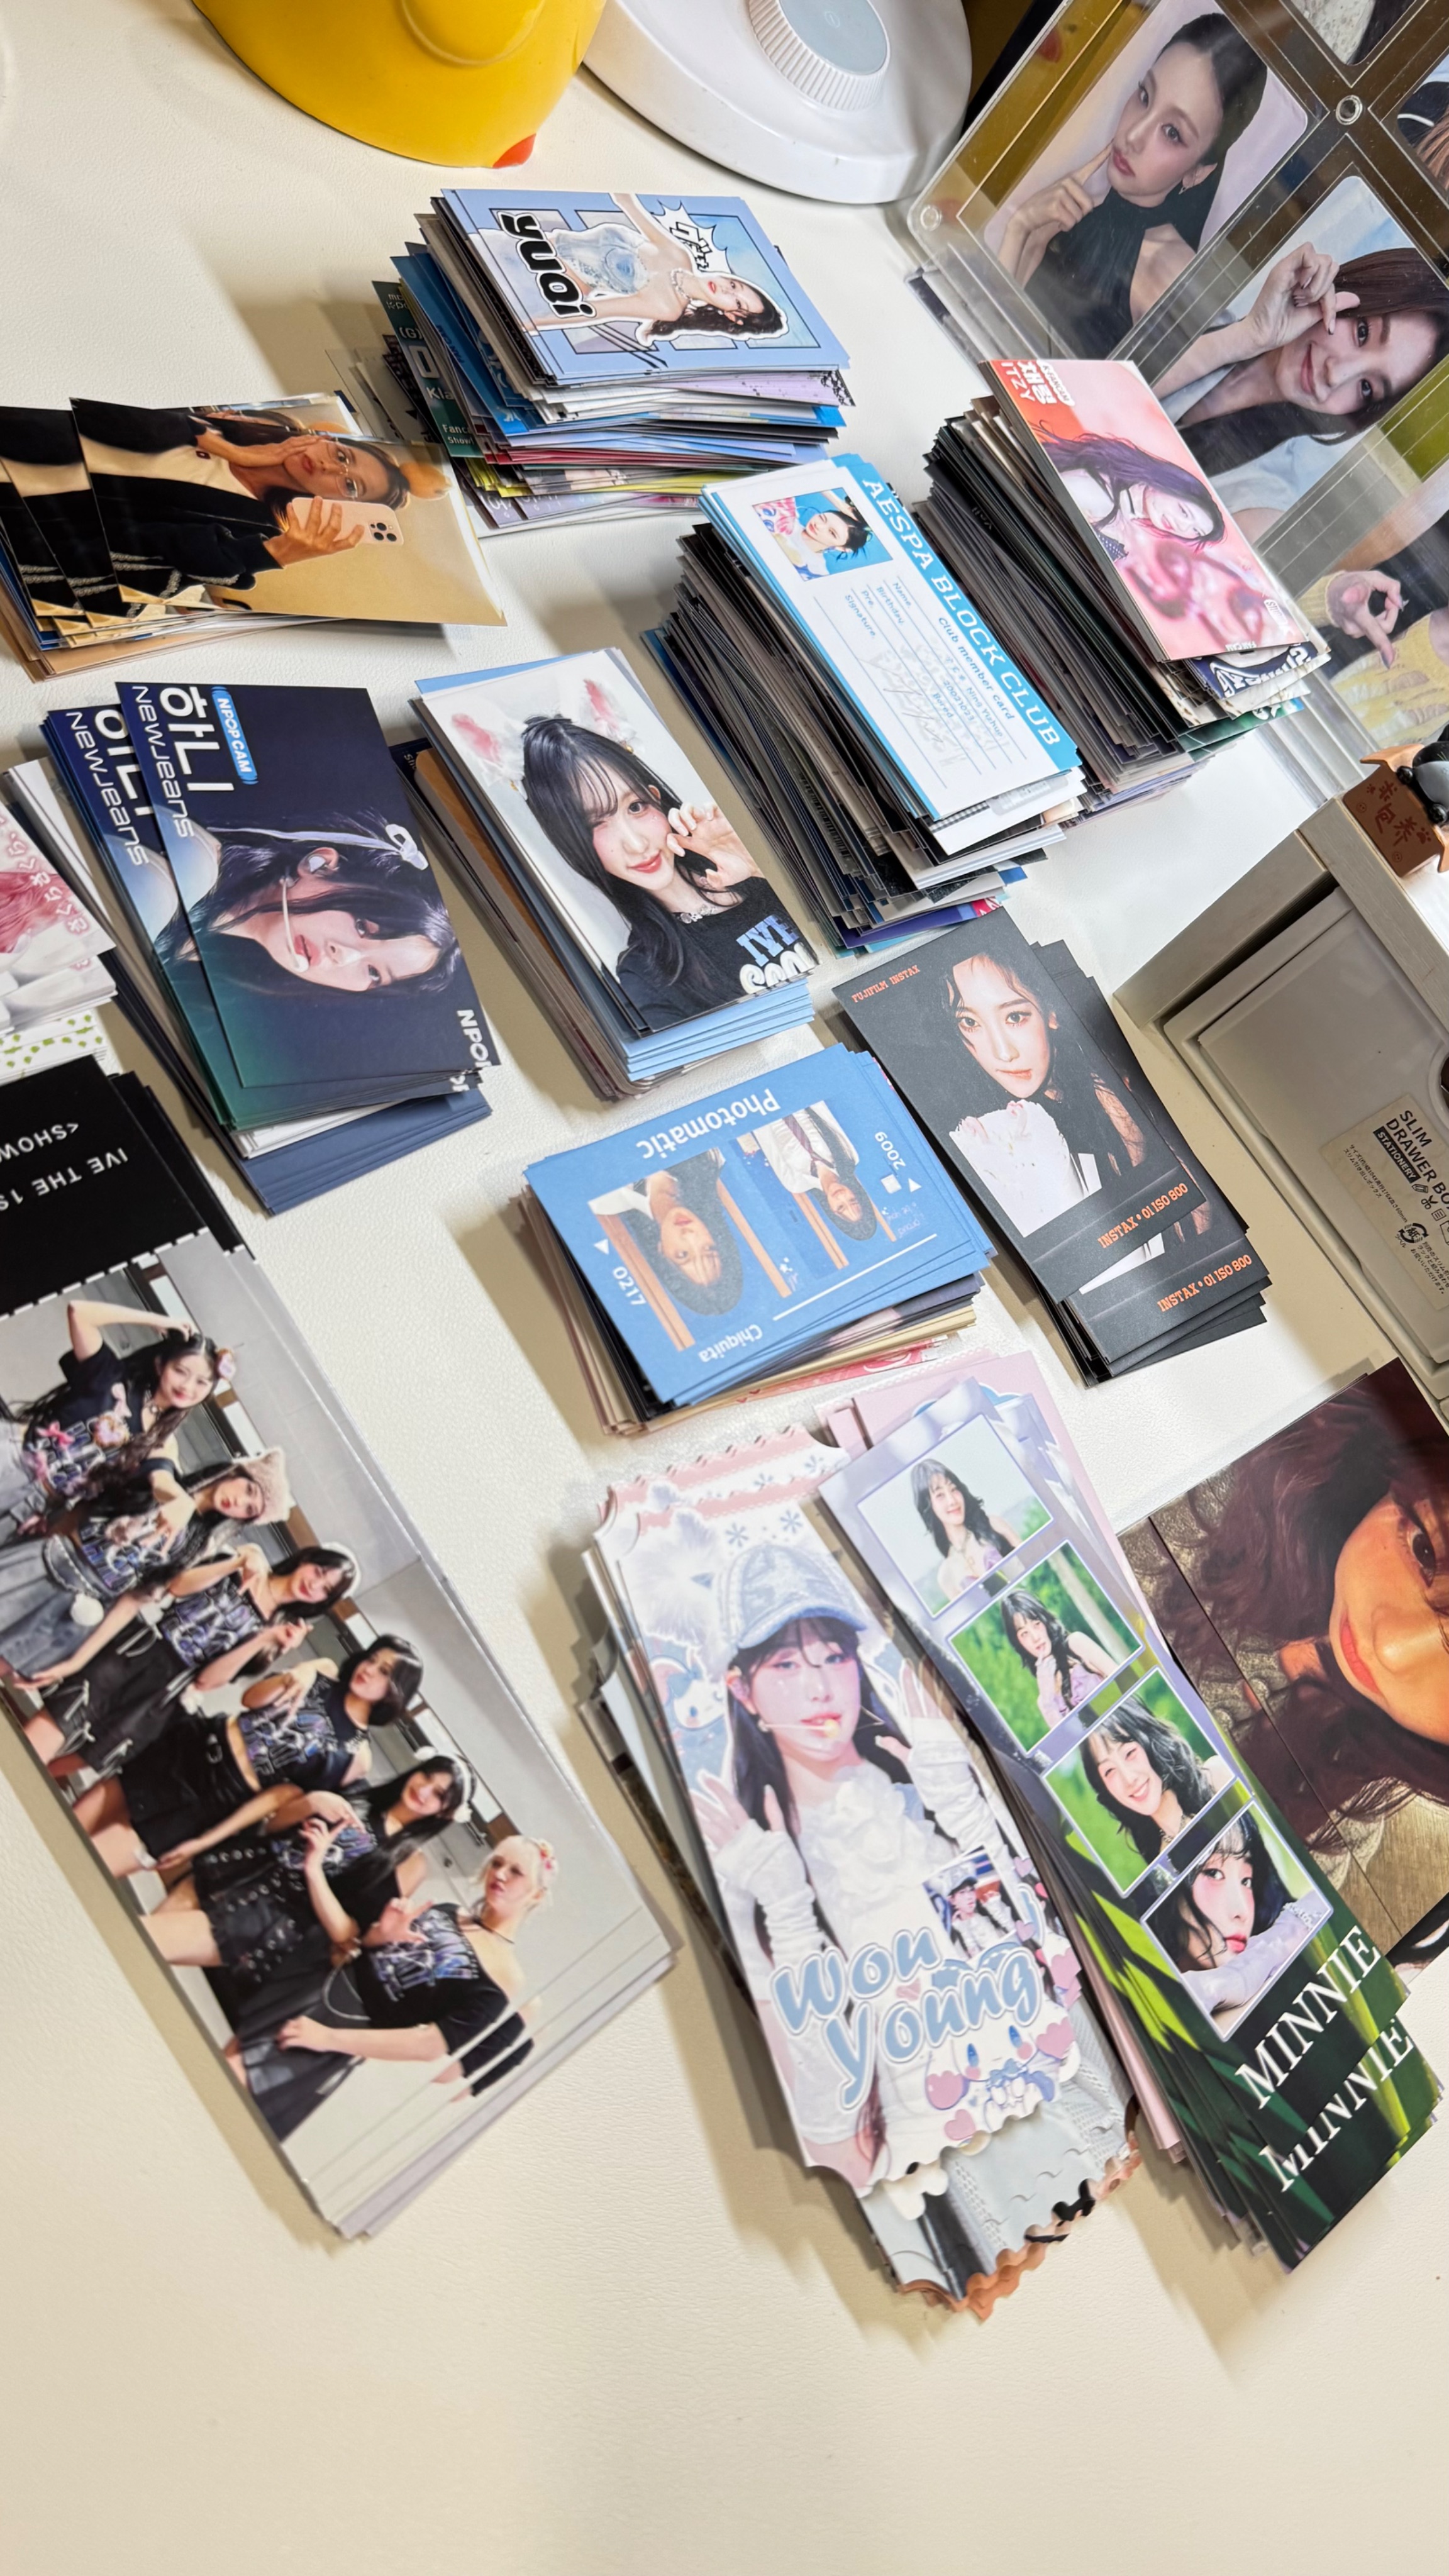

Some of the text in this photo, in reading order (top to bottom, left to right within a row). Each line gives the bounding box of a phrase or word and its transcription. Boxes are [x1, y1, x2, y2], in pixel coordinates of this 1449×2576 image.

[1001, 362, 1035, 401] ITZY
[862, 479, 1061, 745] AESPA BLOCK CLUB
[938, 616, 959, 643] Club
[957, 646, 994, 692] member
[992, 694, 1016, 720] card
[159, 686, 235, 791] 하니
[216, 698, 252, 772] NPOP CAM
[735, 914, 799, 967] IVE
[852, 965, 921, 1003] FUJIFILM INSTAX
[636, 1088, 781, 1160] Photomatic
[1400, 1109, 1433, 1147] SLIM
[91, 1147, 128, 1174] IVE
[874, 1131, 906, 1171] 2009
[1376, 1130, 1416, 1180] STATIONERY
[1385, 1118, 1449, 1210] DRAWER BO
[31, 1167, 82, 1196] THE
[1097, 1216, 1140, 1249] INSTAX
[1150, 1194, 1171, 1213] ISO
[1168, 1182, 1189, 1201] 800
[612, 1266, 646, 1306] 0217
[1157, 1282, 1200, 1313] INSTAX
[1213, 1264, 1233, 1281] ISO
[1231, 1253, 1253, 1272] 800
[698, 1323, 763, 1363] Chiquita
[1234, 1924, 1382, 2111] MINNIE
